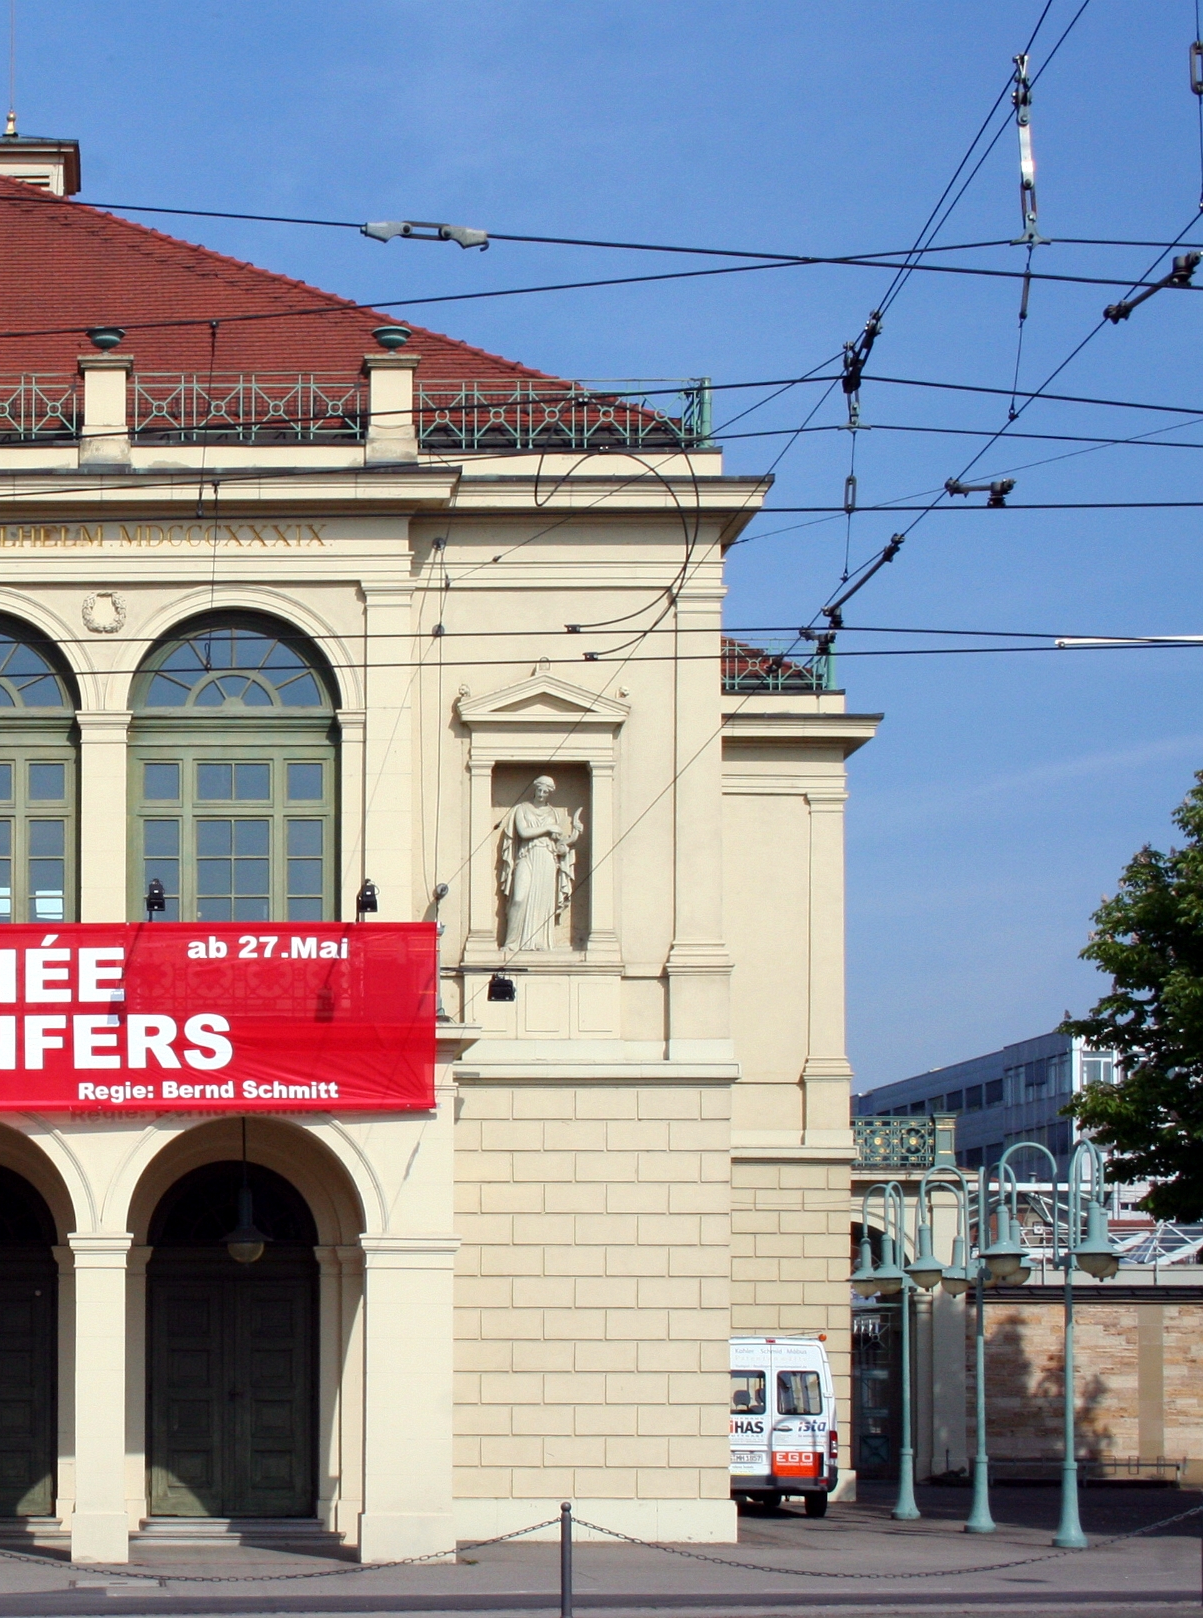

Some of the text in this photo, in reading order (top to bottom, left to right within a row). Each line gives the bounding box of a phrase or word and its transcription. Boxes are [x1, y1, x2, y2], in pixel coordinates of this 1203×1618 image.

[187, 935, 228, 959] ab
[78, 1080, 340, 1104] Regie: Bernd Schmitt
[798, 1419, 827, 1432] ista
[776, 1452, 813, 1462] EGO
